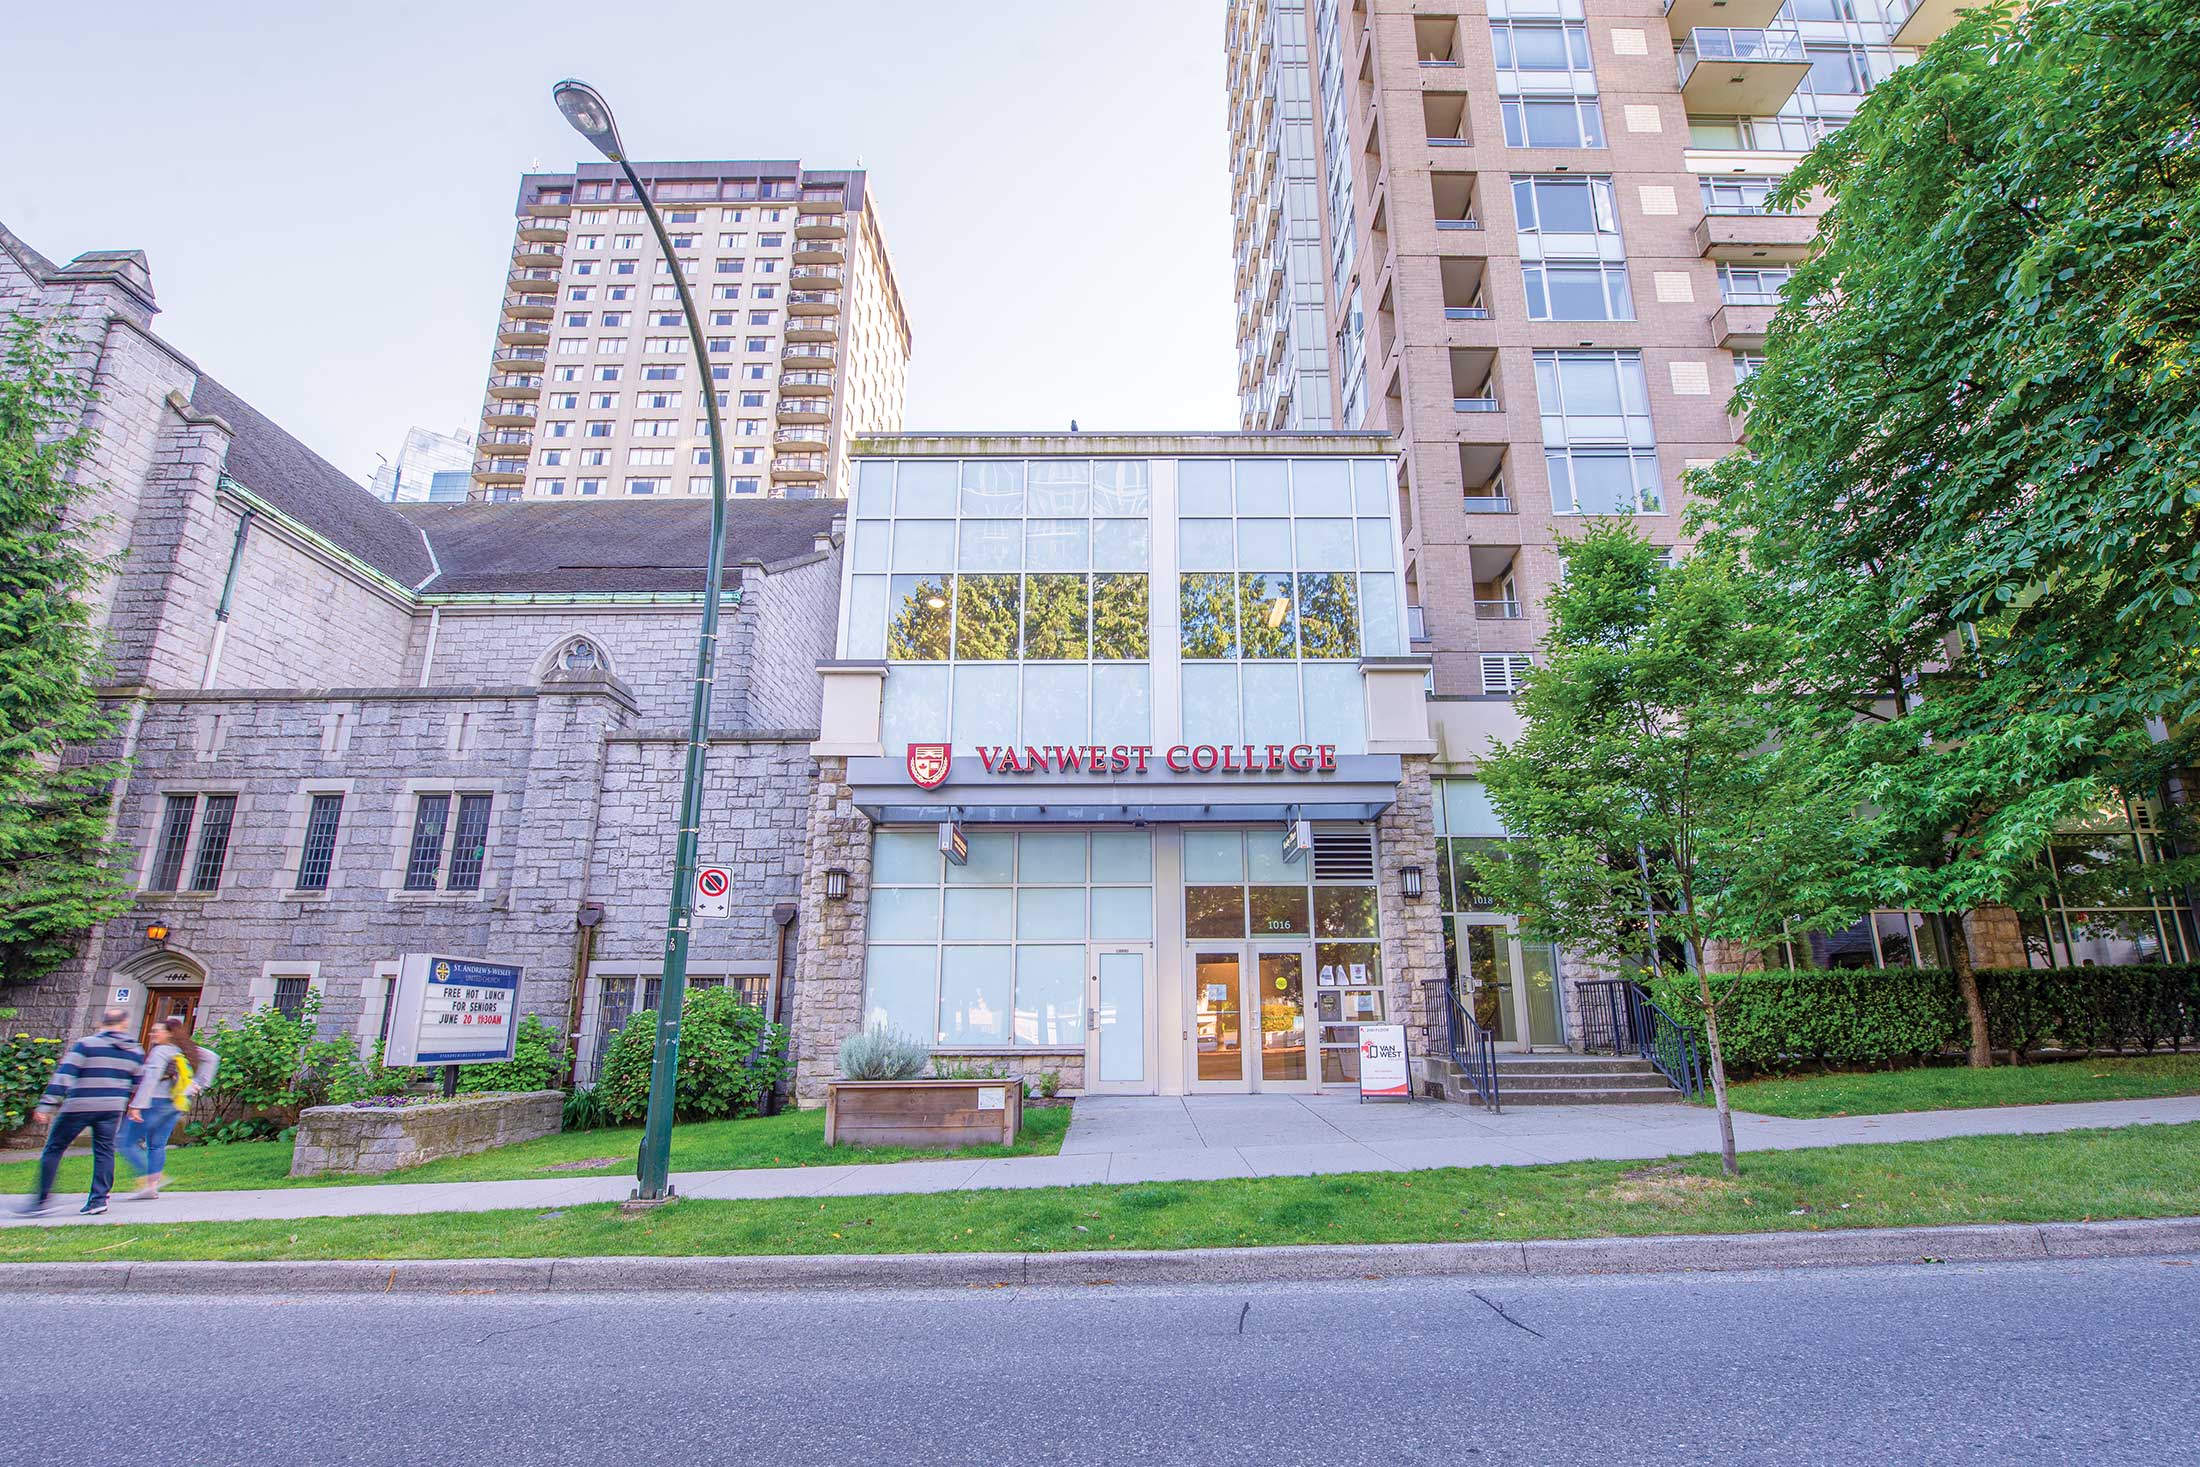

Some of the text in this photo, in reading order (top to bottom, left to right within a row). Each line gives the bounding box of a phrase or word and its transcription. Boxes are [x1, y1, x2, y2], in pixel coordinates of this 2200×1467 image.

[975, 744, 1337, 774] VANWEST COLLEGE
[1473, 896, 1493, 905] 1018
[1268, 920, 1291, 930] 1016
[443, 987, 505, 1001] FREE HOT LUNCH
[452, 1001, 497, 1013] FOR SENIORS
[439, 1014, 458, 1024] JUNE
[463, 1014, 472, 1024] 20
